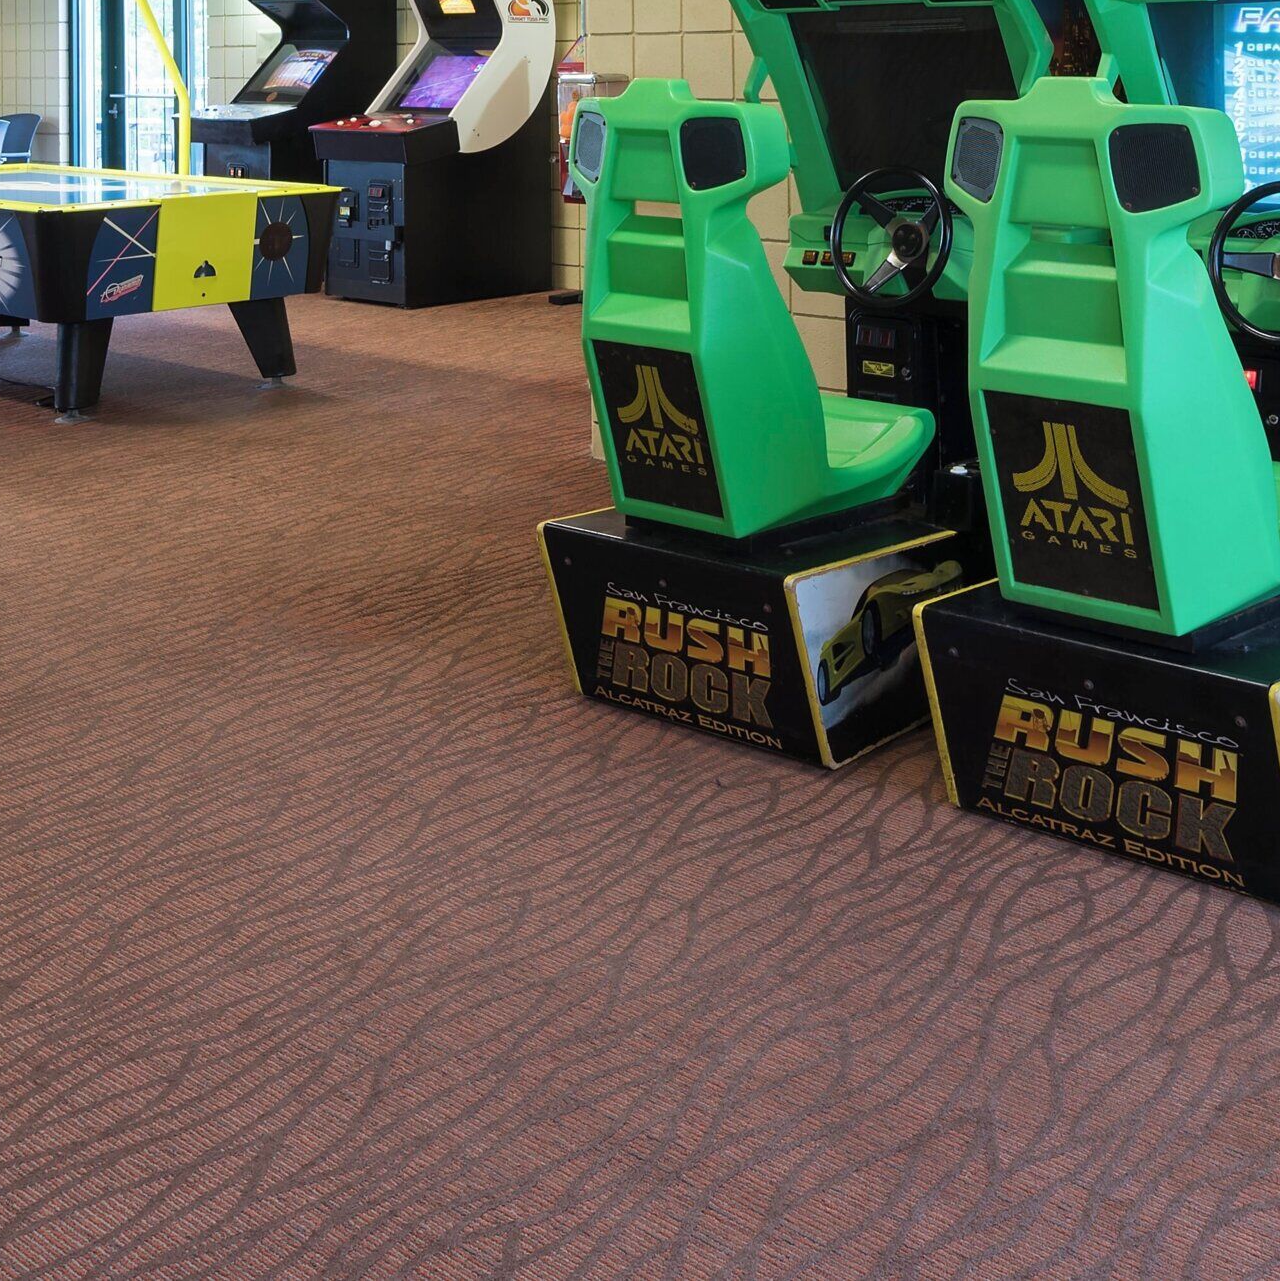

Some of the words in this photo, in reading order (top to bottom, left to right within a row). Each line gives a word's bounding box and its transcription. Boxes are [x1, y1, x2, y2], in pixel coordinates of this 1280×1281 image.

[1234, 41, 1244, 57] 1
[625, 430, 705, 467] ATARI
[626, 454, 708, 477] GAMES
[1020, 497, 1135, 546] ATARI
[1022, 529, 1138, 560] GAMES
[606, 581, 649, 605] San
[653, 592, 769, 632] Francisco
[596, 638, 618, 680] THE
[601, 596, 772, 679] RUSH
[611, 641, 775, 731] ROCK
[594, 684, 694, 725] ALCATRAZ
[697, 714, 784, 751] EDITION
[1004, 677, 1065, 706] San
[1074, 693, 1240, 749] Francisco
[982, 743, 1011, 791] THE
[994, 694, 1240, 806] RUSH
[1004, 749, 1239, 863] ROCK
[976, 796, 1120, 849] ALCATRAZ
[1122, 838, 1247, 889] EDITION
